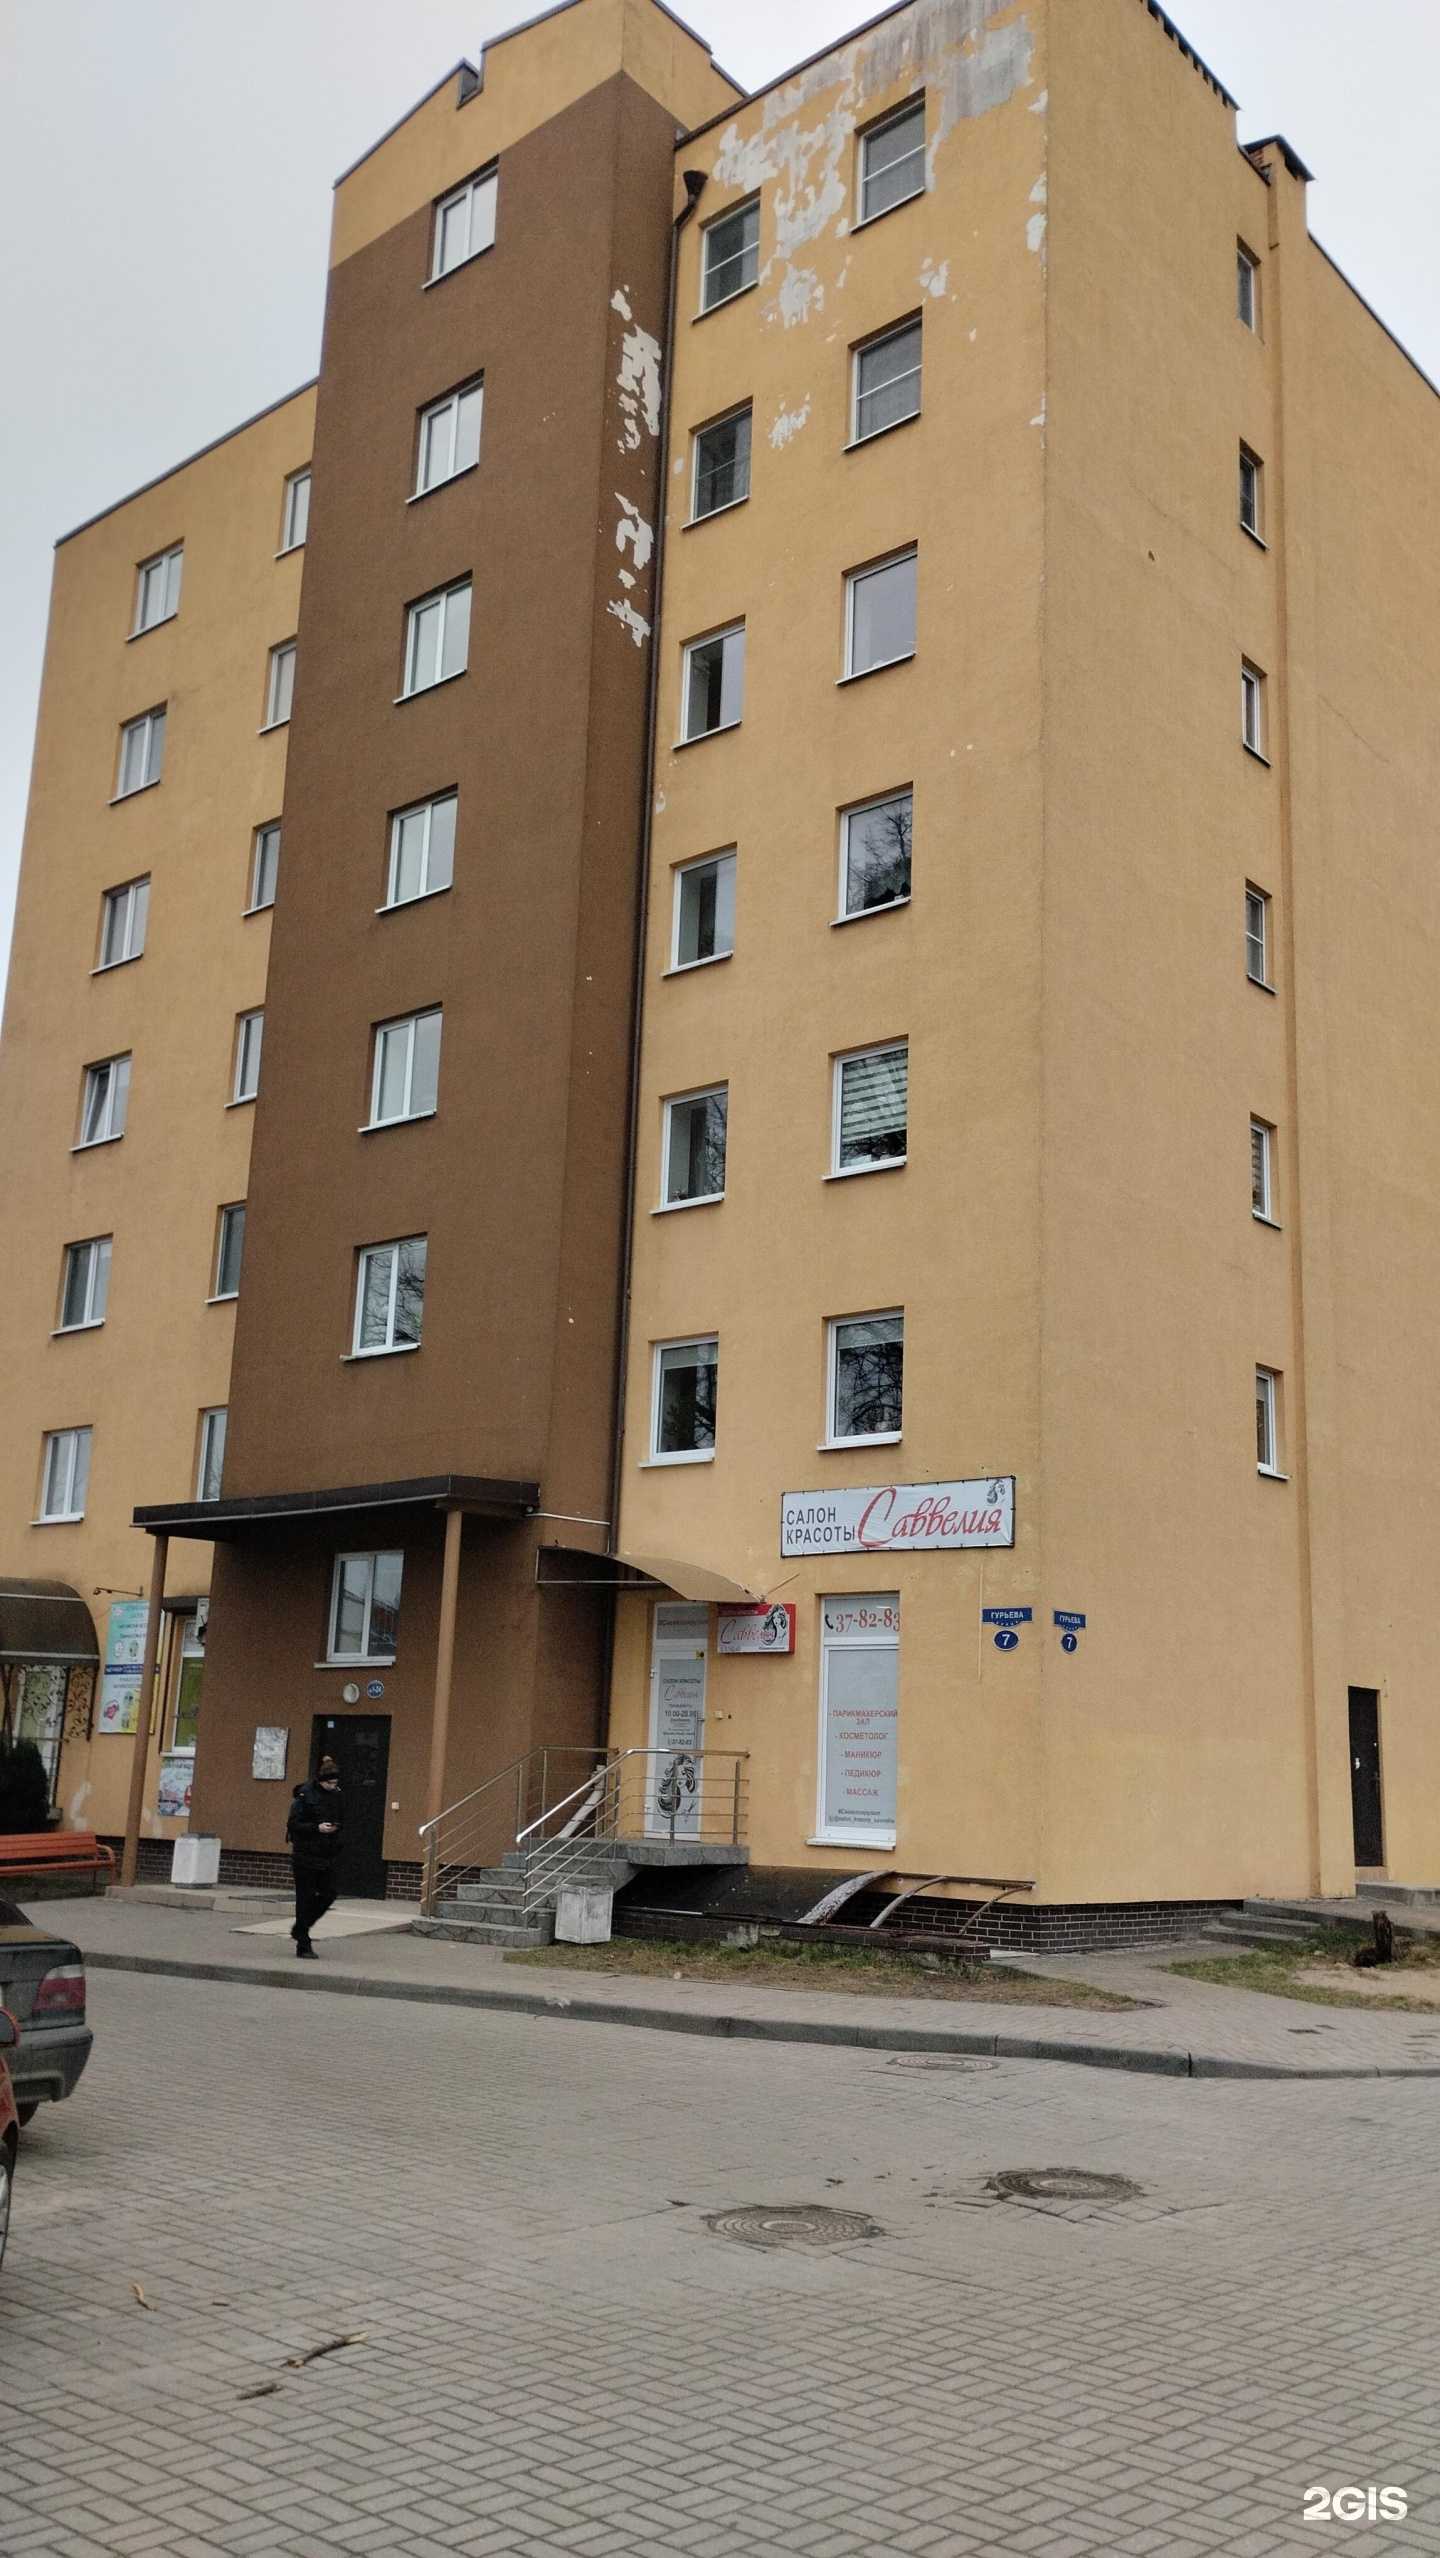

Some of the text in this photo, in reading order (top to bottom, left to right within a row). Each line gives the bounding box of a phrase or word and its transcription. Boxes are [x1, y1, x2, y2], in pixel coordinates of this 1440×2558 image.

[786, 1507, 837, 1526] САЛОН
[857, 1487, 1003, 1548] Саввелия
[786, 1526, 855, 1544] КРАСОТЫ
[836, 1608, 900, 1632] 37-82-83
[991, 1611, 1024, 1619] ГУРЬЕВА
[1060, 1614, 1081, 1624] ГУРЬЕВА
[1002, 1634, 1010, 1646] 7
[1066, 1637, 1073, 1649] 7
